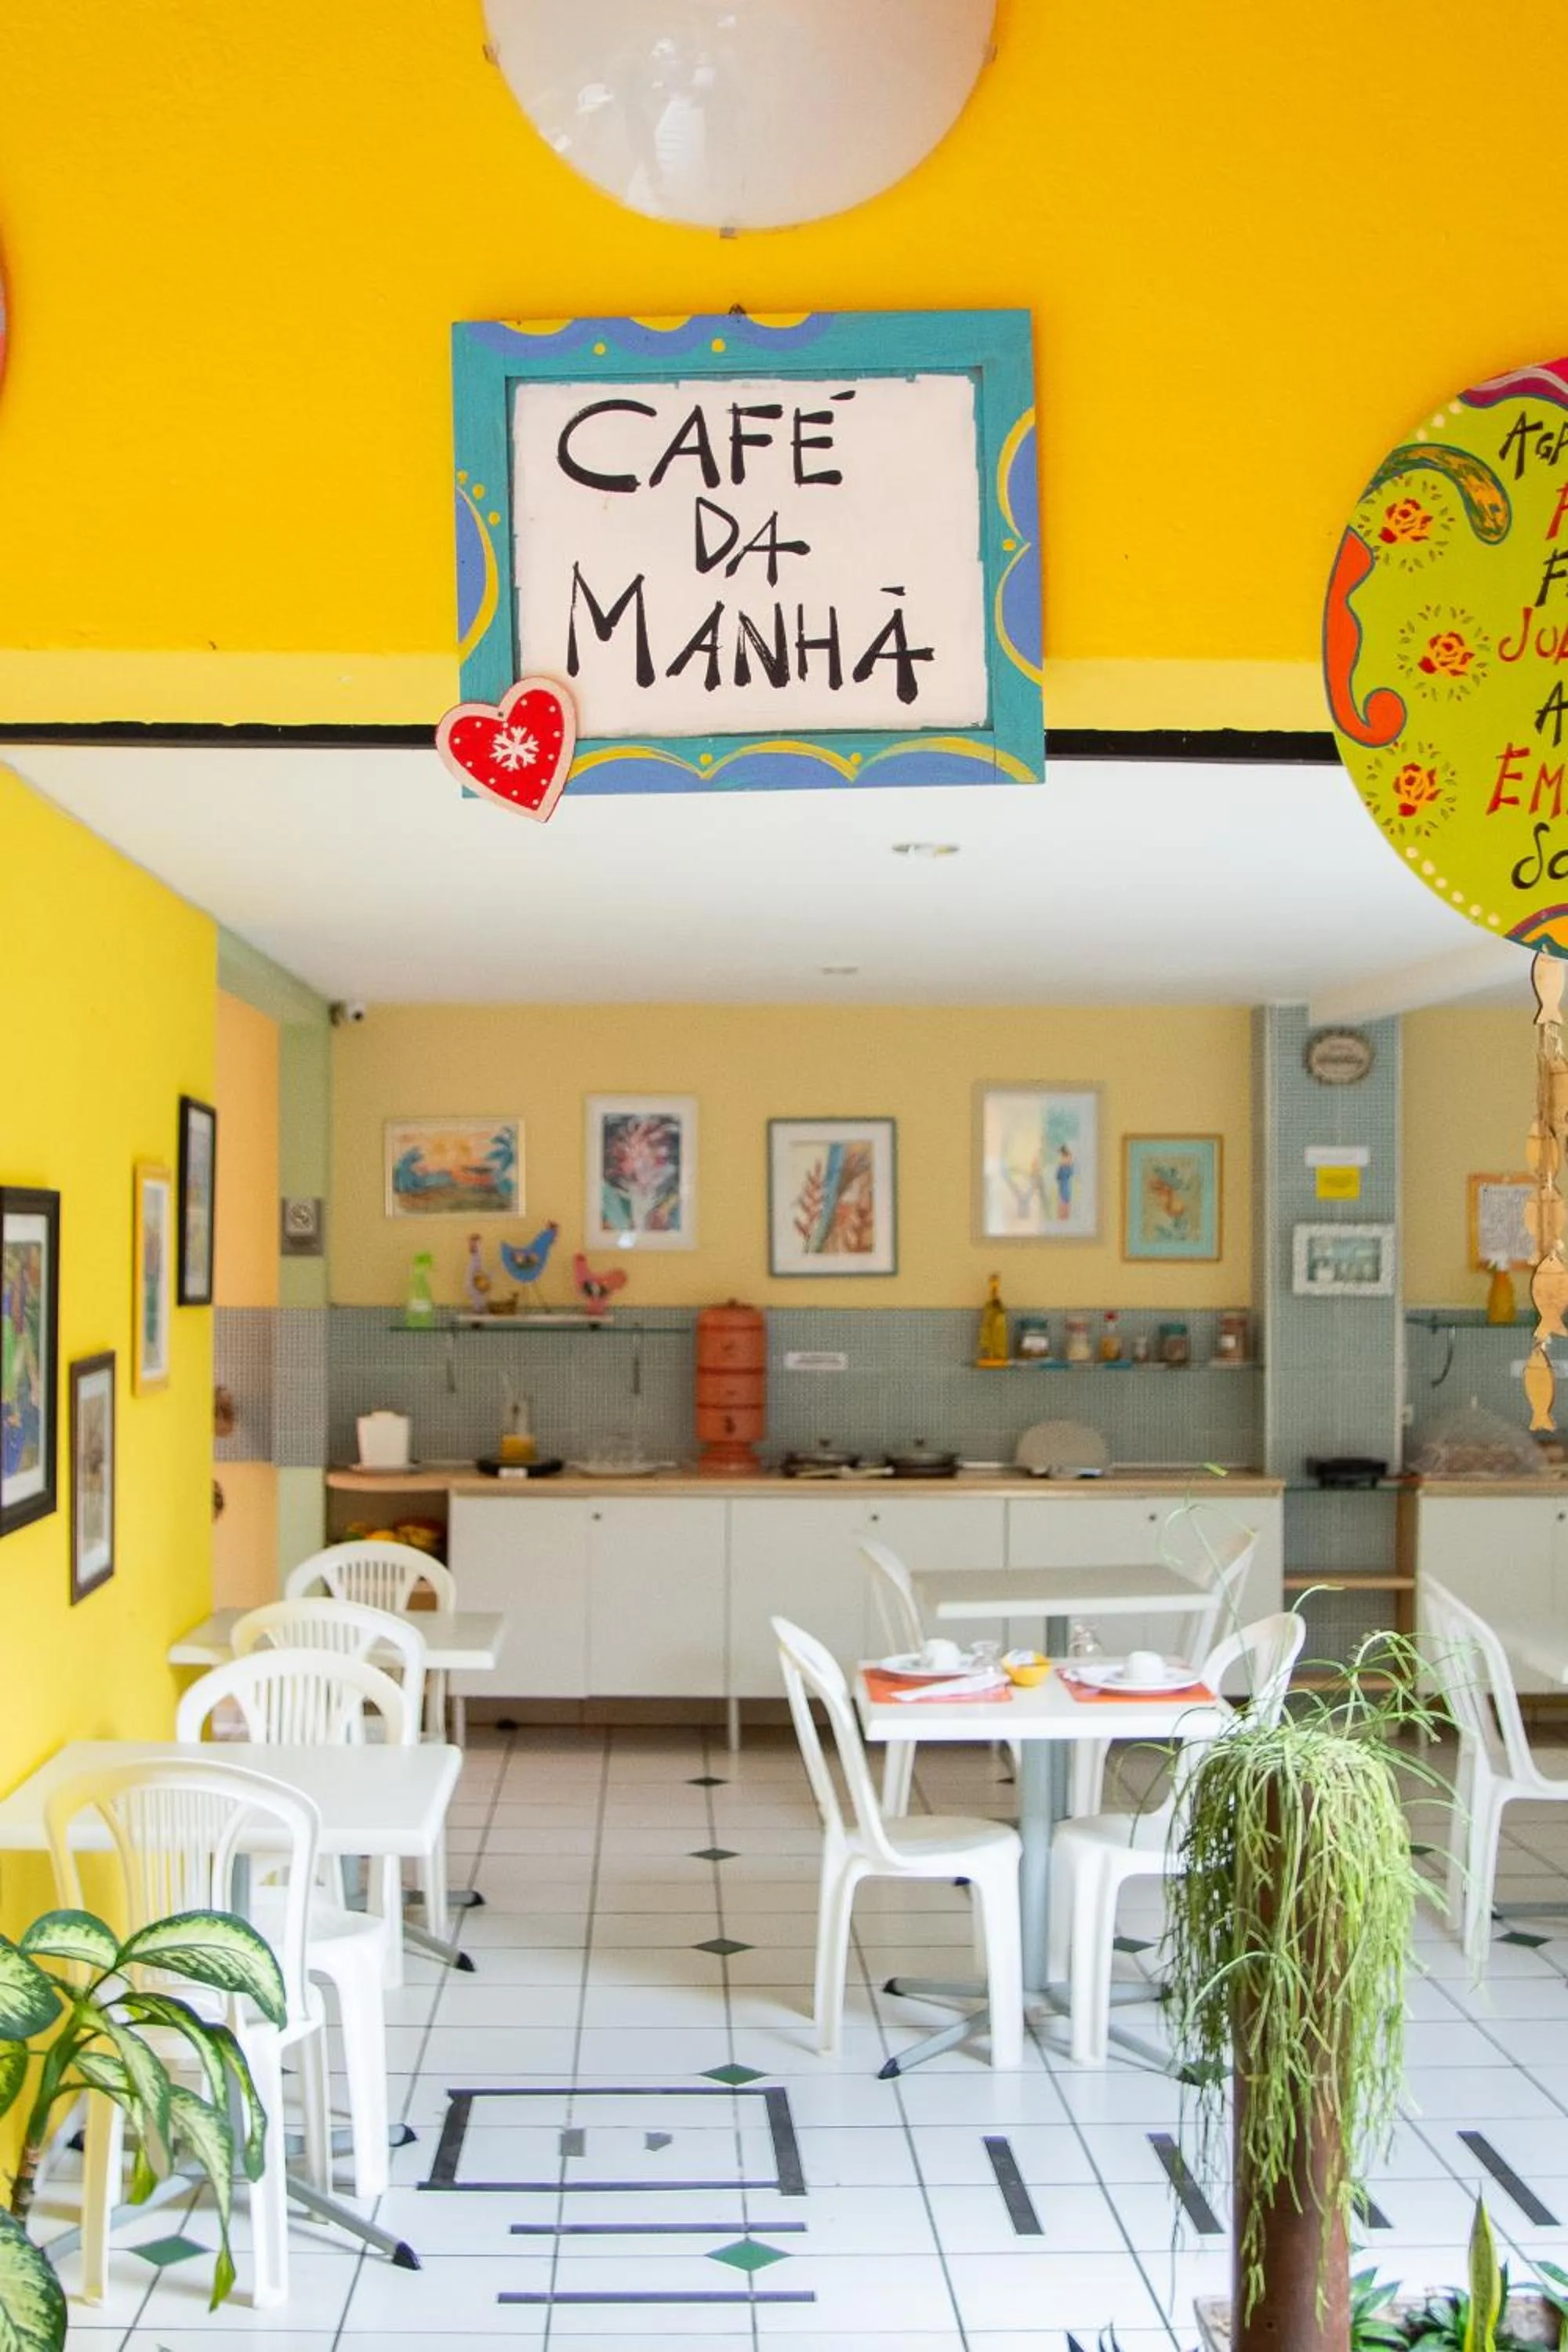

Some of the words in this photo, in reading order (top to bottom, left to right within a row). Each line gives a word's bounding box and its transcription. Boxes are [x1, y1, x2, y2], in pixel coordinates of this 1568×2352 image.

[556, 390, 856, 493] CAFÉ
[695, 496, 811, 588] DA
[1486, 742, 1568, 819] EM
